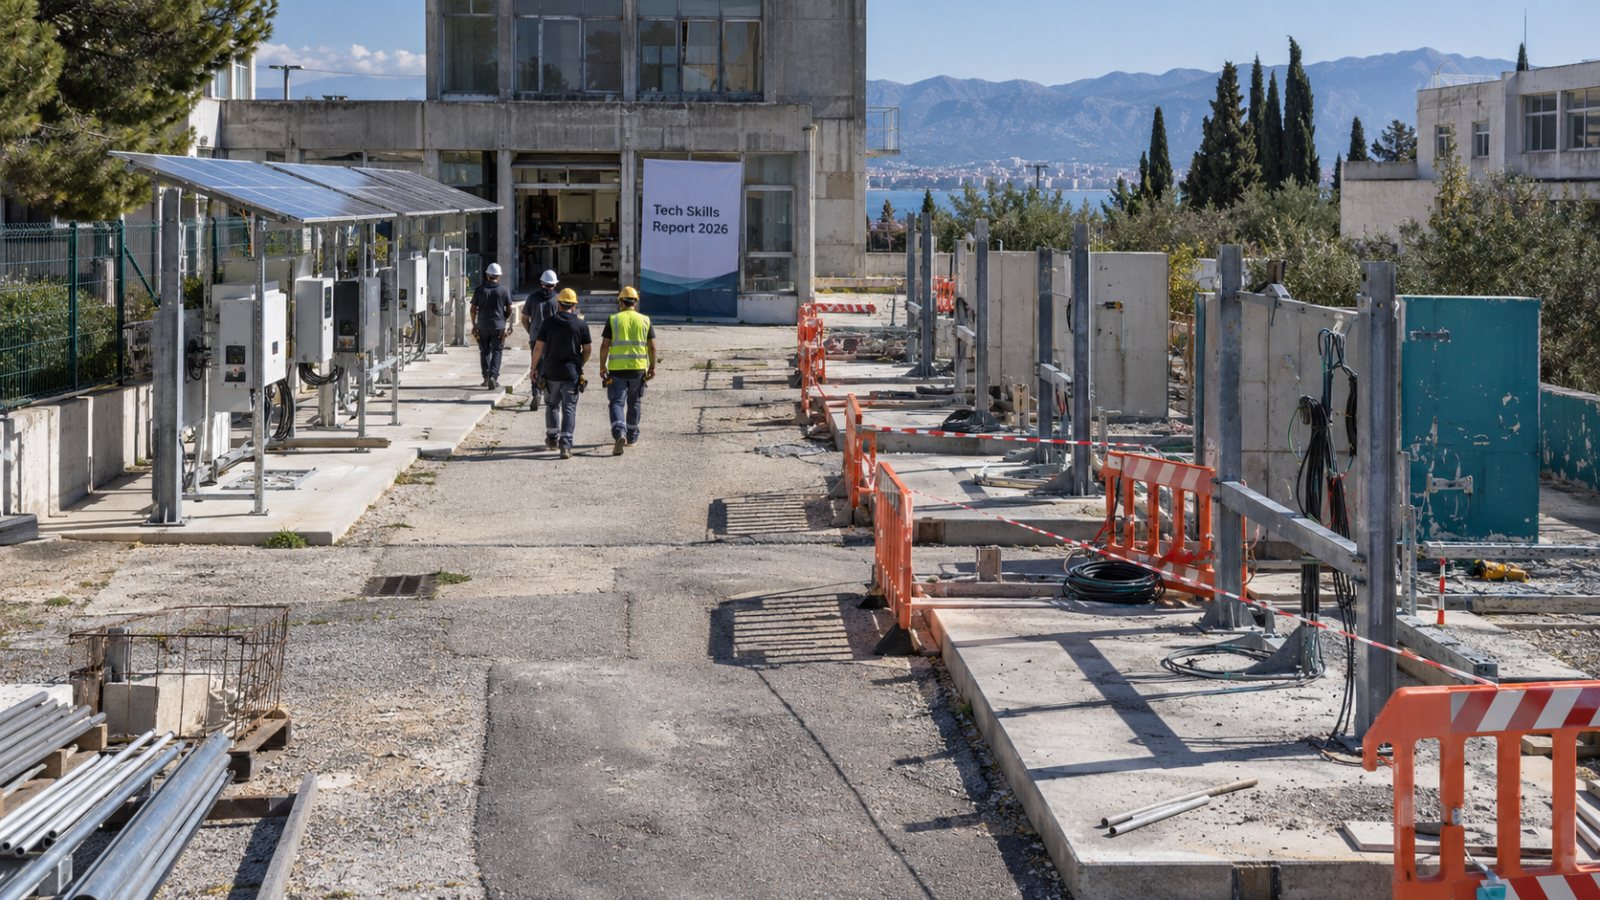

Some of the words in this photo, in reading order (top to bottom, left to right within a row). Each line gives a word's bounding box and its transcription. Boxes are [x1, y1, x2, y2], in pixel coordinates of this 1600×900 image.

[653, 204, 683, 216] Tech
[686, 205, 720, 218] Skills
[652, 220, 695, 235] Report
[698, 223, 729, 235] 2026
